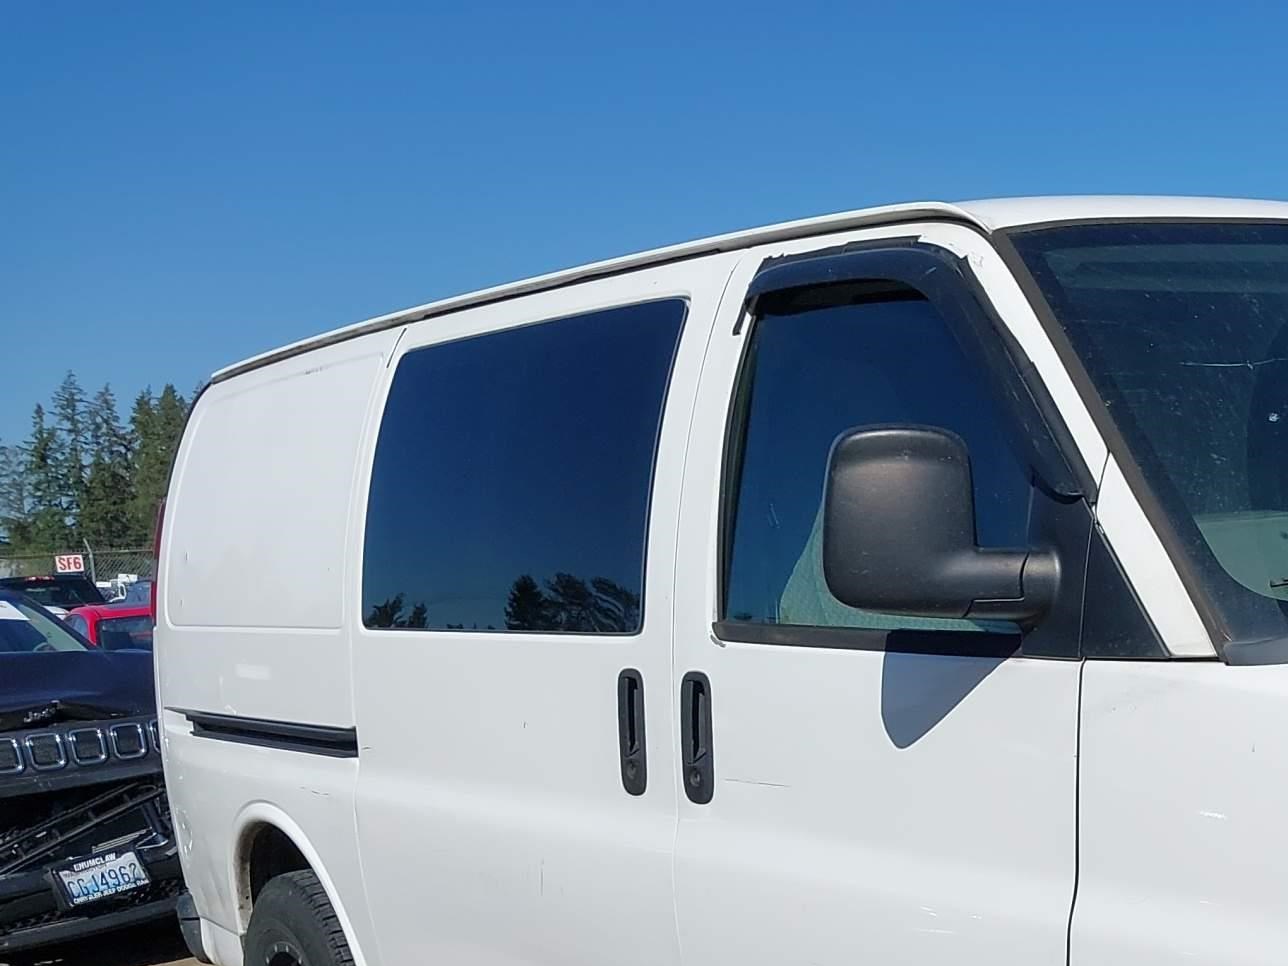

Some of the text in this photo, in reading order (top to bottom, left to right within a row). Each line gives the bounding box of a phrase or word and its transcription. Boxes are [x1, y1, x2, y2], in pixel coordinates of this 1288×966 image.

[58, 556, 82, 571] SF6
[73, 853, 116, 871] ENUMCLAW
[68, 863, 145, 899] CGJ4962
